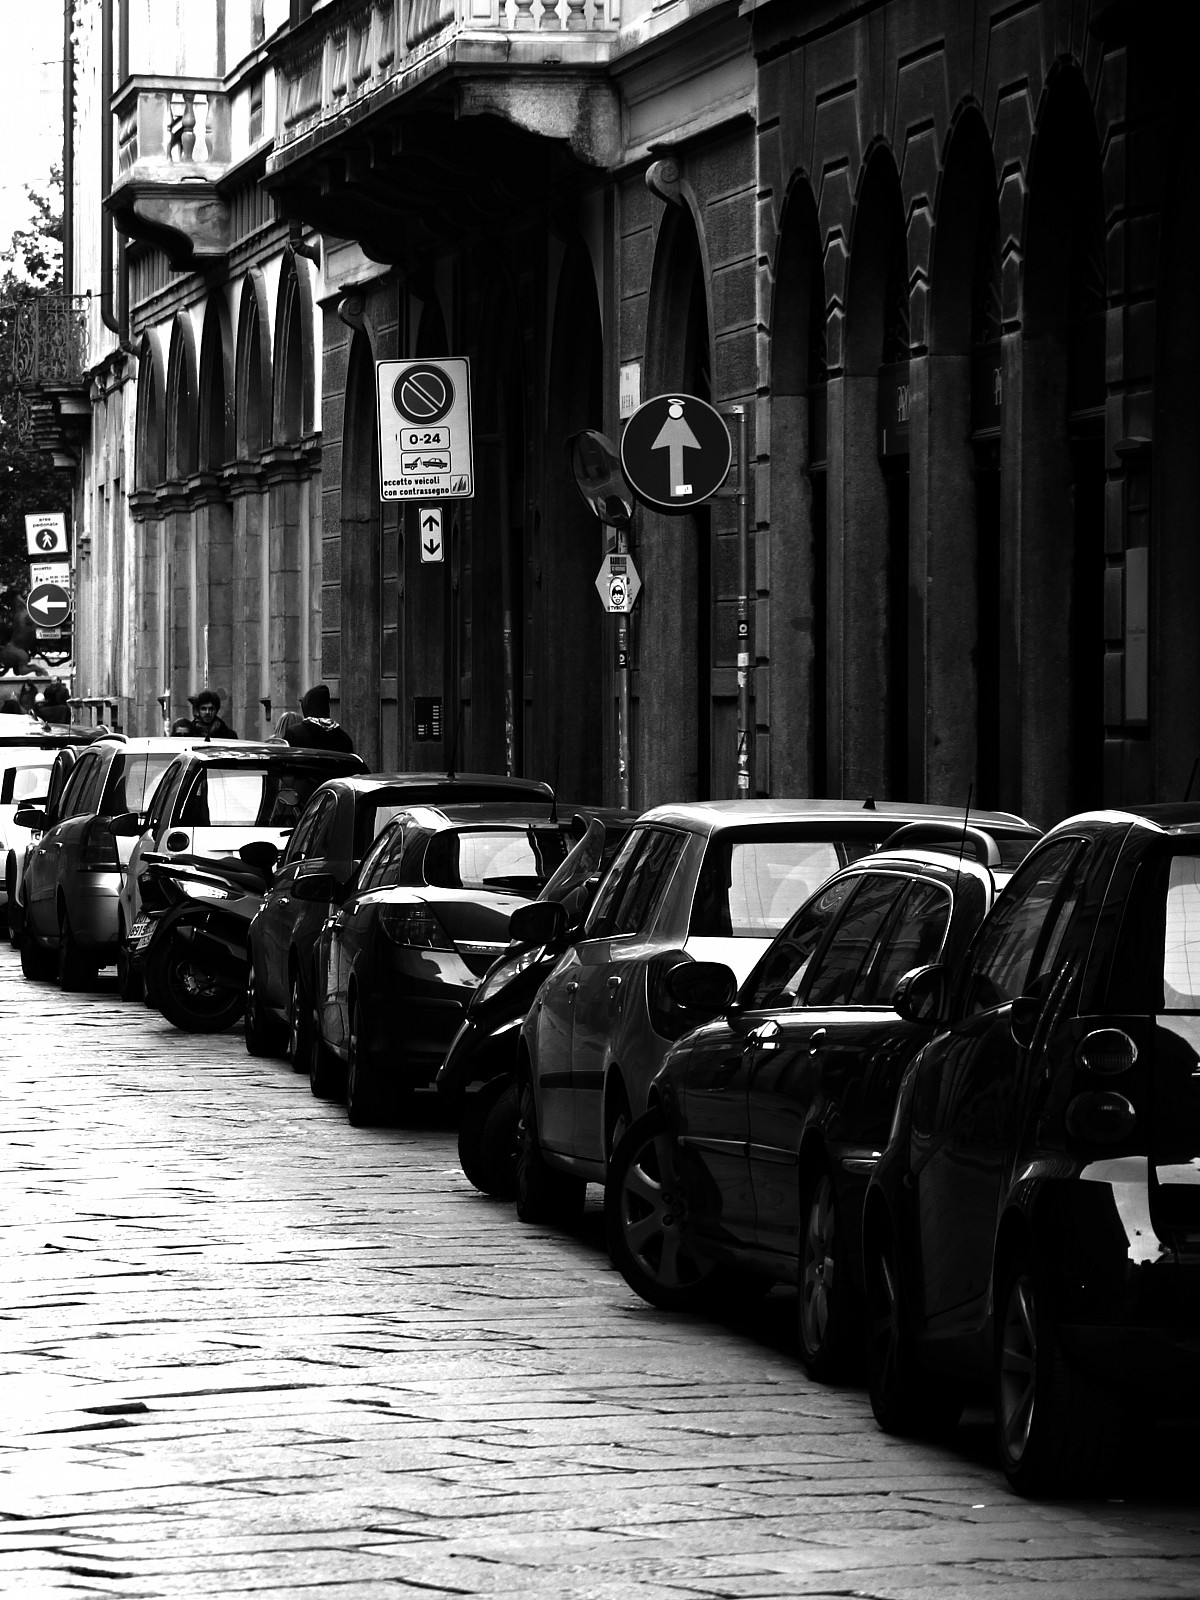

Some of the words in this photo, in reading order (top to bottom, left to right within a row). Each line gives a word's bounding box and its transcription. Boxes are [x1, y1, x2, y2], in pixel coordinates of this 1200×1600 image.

[409, 433, 441, 445] 0-24
[383, 477, 413, 487] eccetto
[414, 475, 440, 485] veicoli
[399, 487, 450, 496] contrassegno
